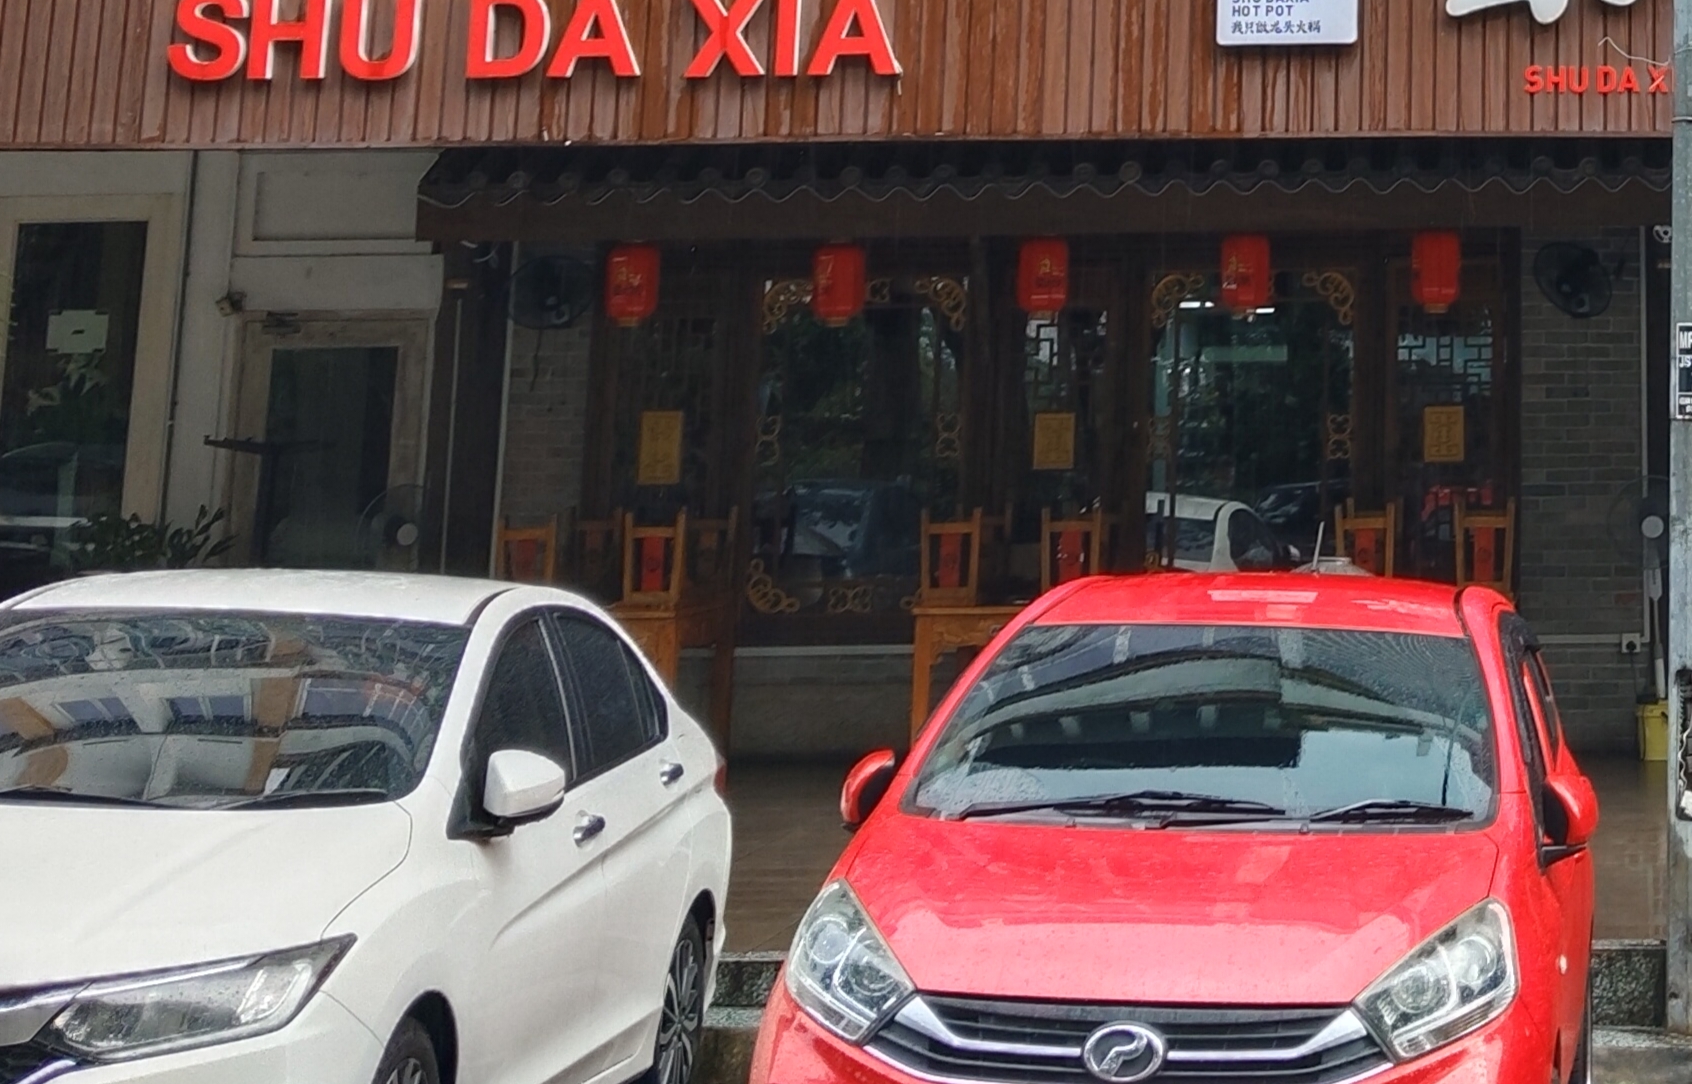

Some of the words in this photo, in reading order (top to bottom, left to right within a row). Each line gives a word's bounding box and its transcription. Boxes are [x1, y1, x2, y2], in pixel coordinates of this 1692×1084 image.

[1231, 5, 1261, 17] HOT
[1265, 5, 1294, 17] POT
[1523, 65, 1589, 94] SHU
[1596, 65, 1640, 93] DA
